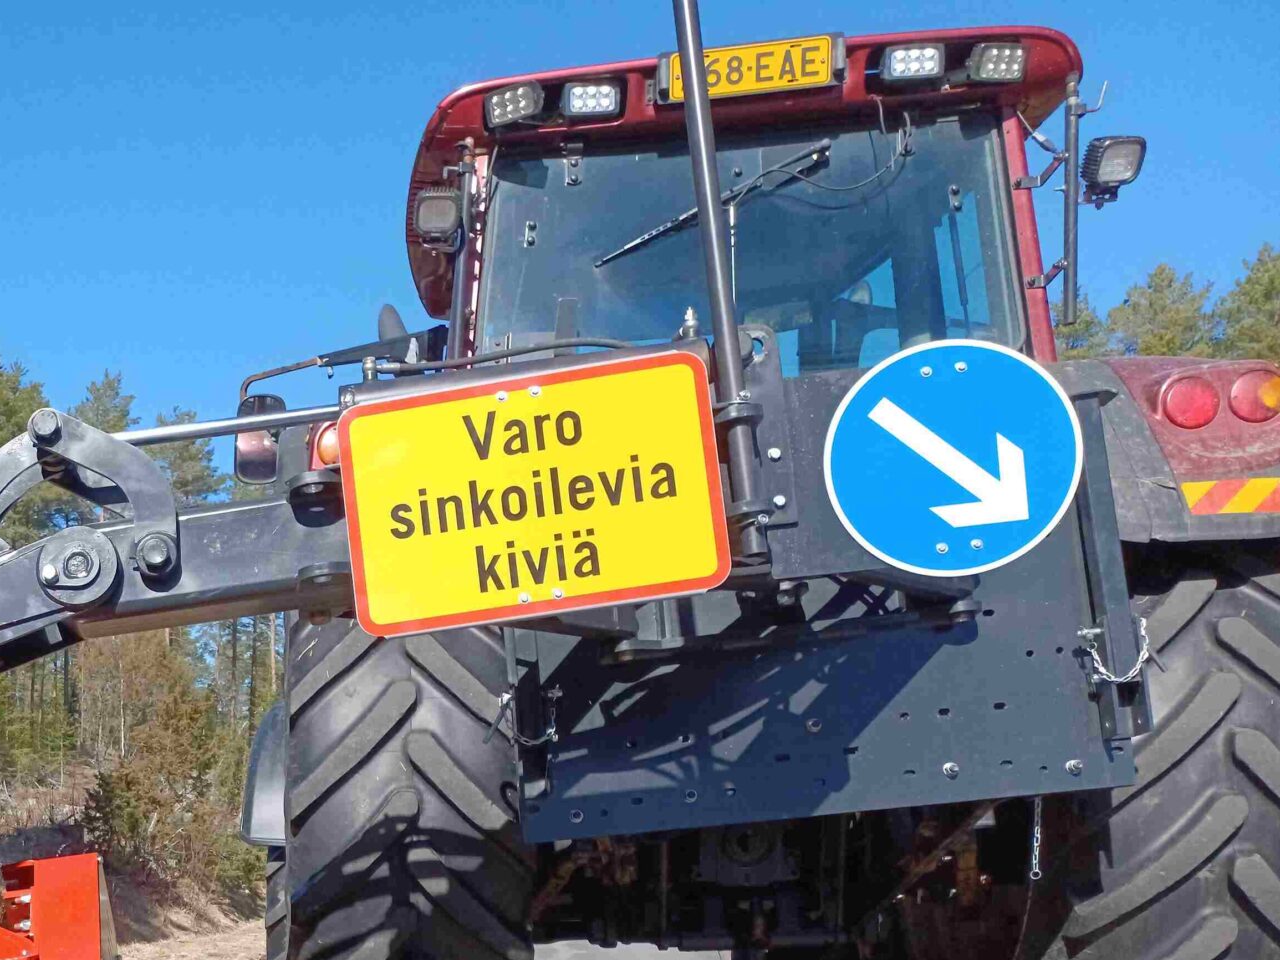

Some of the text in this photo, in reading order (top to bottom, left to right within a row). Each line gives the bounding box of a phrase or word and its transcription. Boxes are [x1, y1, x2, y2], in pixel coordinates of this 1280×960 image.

[704, 45, 821, 89] 68-EAE
[462, 409, 583, 461] Varo
[389, 453, 678, 540] sinkoilevia
[474, 527, 601, 593] kiviä
